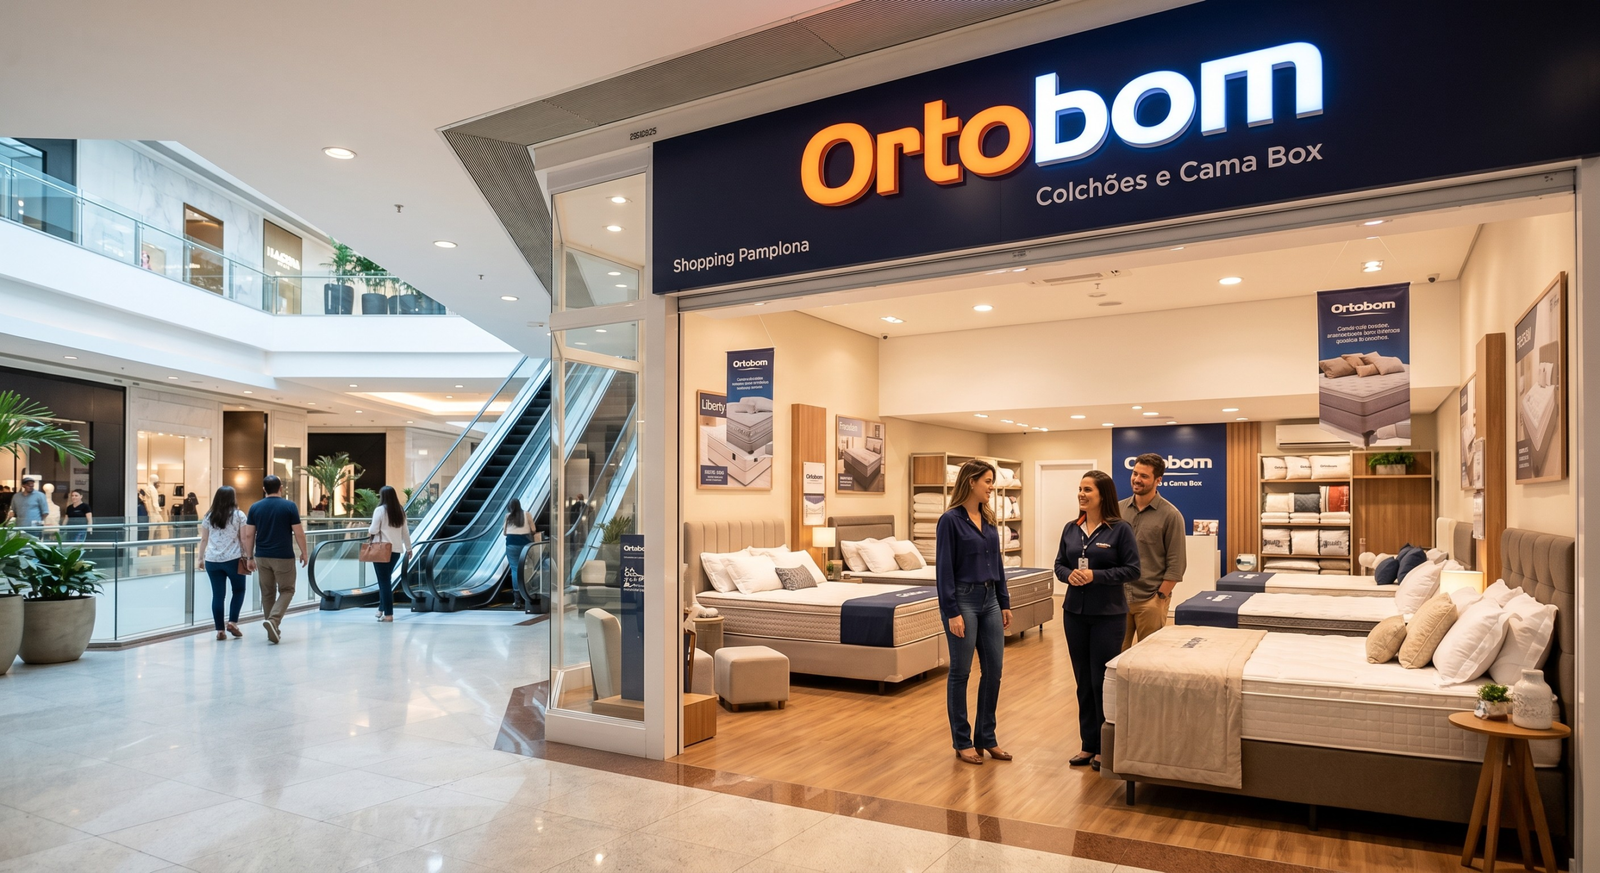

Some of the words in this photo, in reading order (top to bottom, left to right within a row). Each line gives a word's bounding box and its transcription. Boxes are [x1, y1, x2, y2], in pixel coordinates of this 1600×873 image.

[800, 41, 1325, 208] Ortobom
[1035, 173, 1148, 207] Colchões
[1156, 170, 1171, 187] e
[1179, 155, 1257, 183] Cama
[1267, 143, 1324, 169] Box
[673, 252, 735, 273] Shopping
[739, 240, 810, 262] Pamplona
[1330, 301, 1396, 314] Ortobom
[732, 359, 768, 368] Ortobom
[701, 398, 726, 415] Liberty
[1123, 455, 1213, 470] Obom
